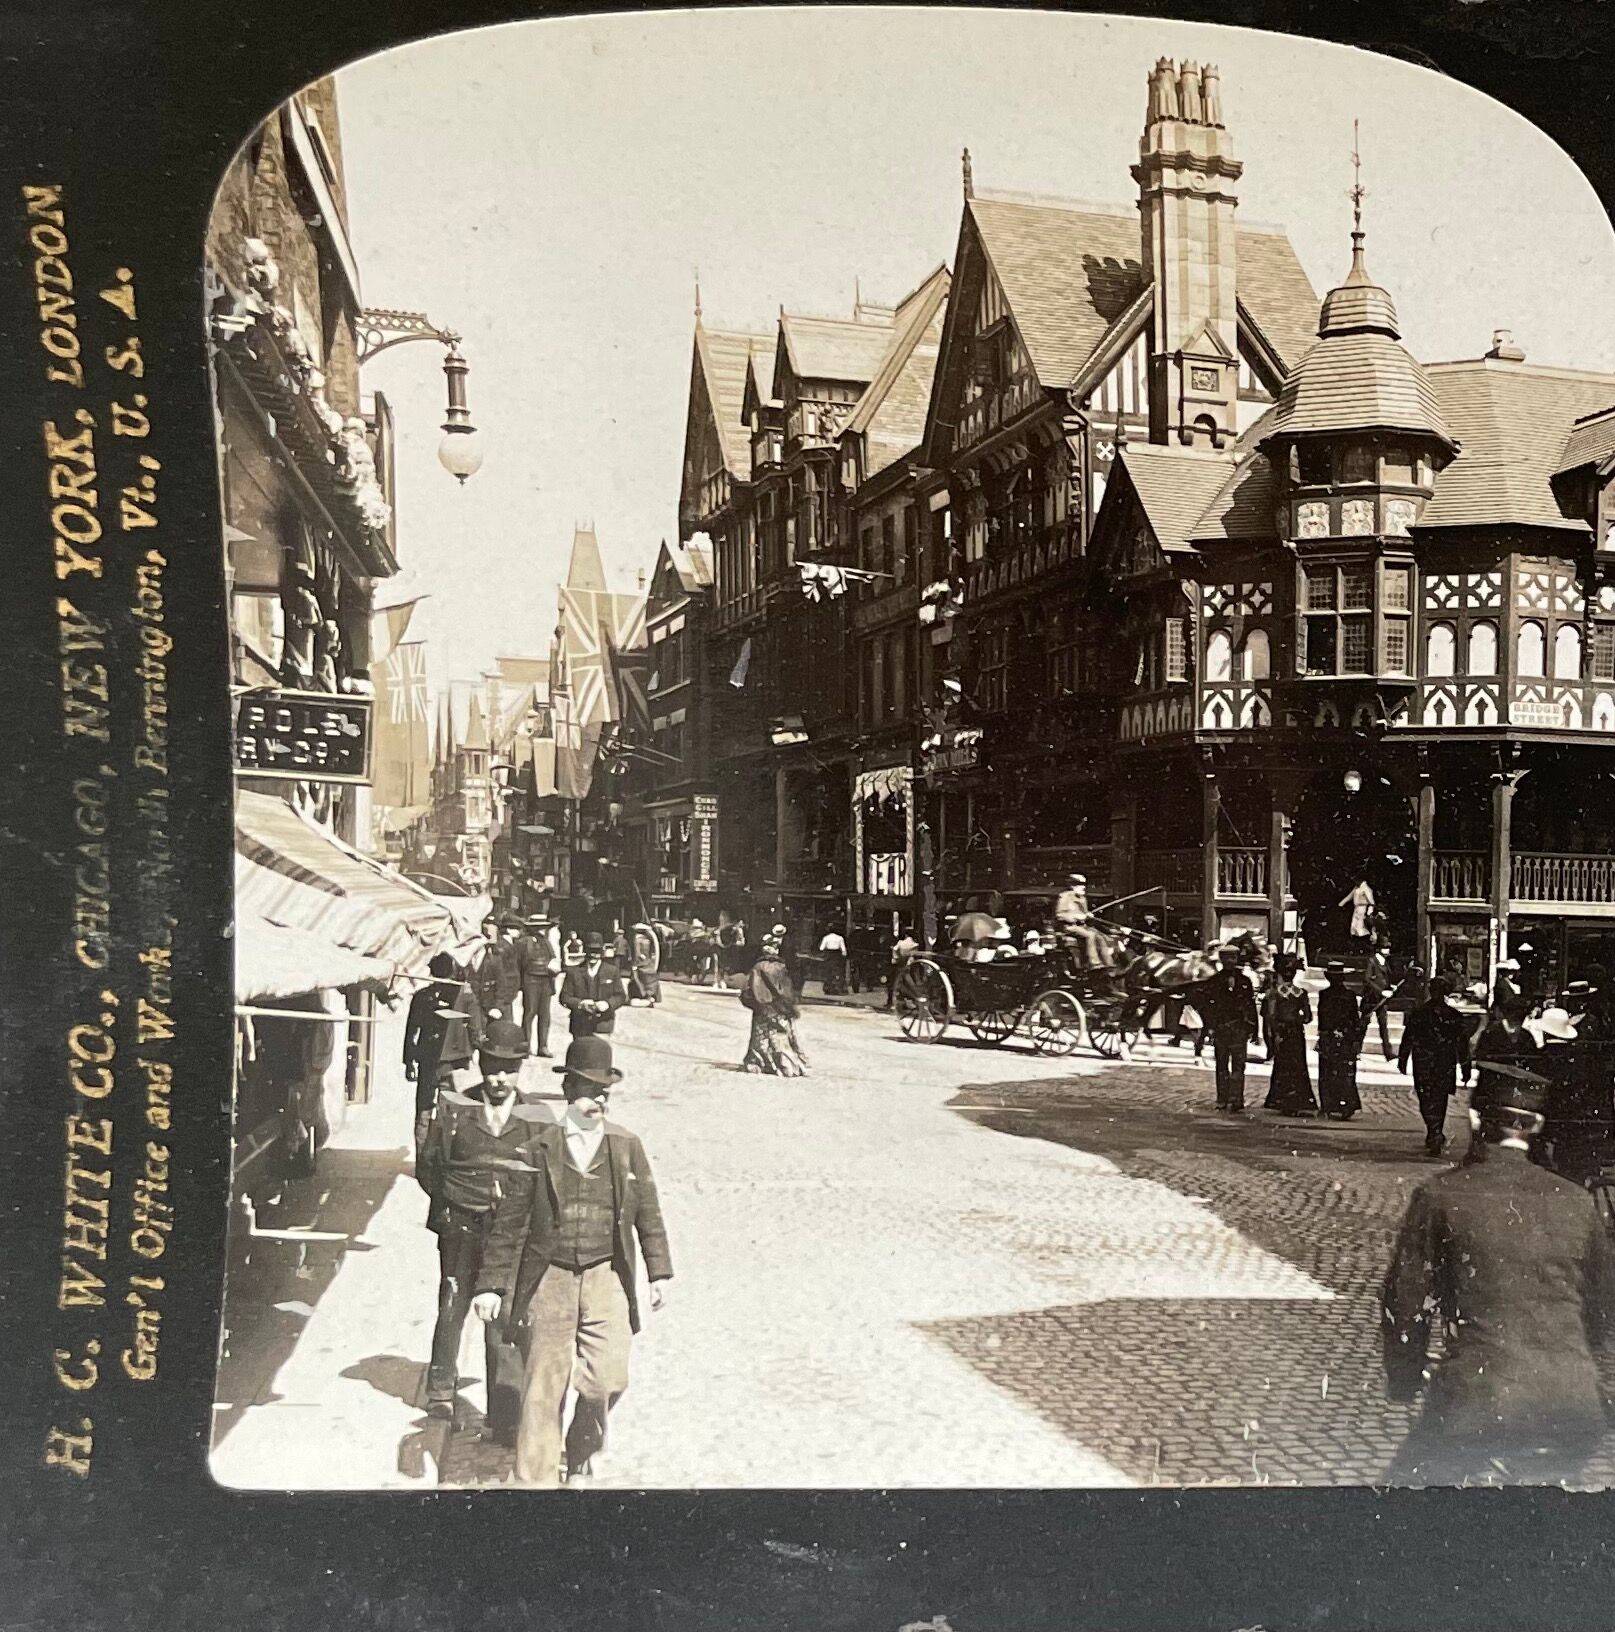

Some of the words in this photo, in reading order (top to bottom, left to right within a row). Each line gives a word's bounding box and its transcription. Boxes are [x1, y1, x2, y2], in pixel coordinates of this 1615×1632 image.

[22, 184, 85, 388] LONDON
[99, 268, 139, 320] A.
[104, 338, 143, 377] S.
[111, 394, 151, 437] U.
[44, 409, 101, 579] YORK,
[120, 455, 161, 530] Vt.,
[56, 597, 110, 742] NEW
[130, 549, 174, 775] Bennington,
[1513, 703, 1560, 714] BRIDGE
[1513, 714, 1560, 725] STREET
[74, 764, 119, 969] CHICAGO,
[67, 989, 121, 1098] CO.,
[137, 1058, 172, 1130] and
[57, 1115, 113, 1310] WHITE
[130, 1141, 174, 1259] Office
[55, 1340, 100, 1389] C.
[43, 1417, 94, 1480] H.
